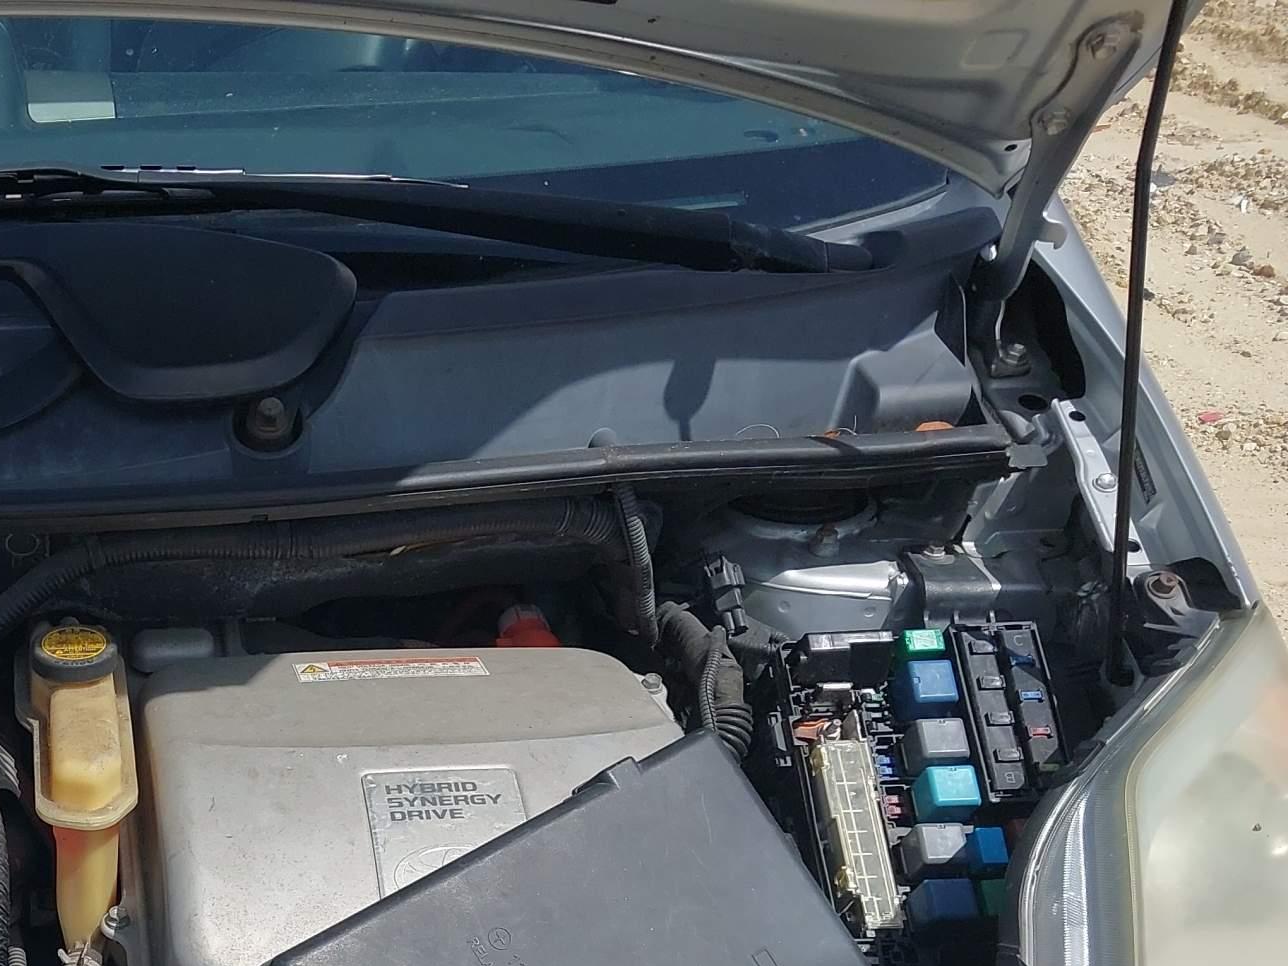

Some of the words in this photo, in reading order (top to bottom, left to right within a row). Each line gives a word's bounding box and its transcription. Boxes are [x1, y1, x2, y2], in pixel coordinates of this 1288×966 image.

[384, 781, 478, 795] HYBRID
[386, 794, 502, 809] SYNERGY
[390, 808, 465, 822] DRIVE
